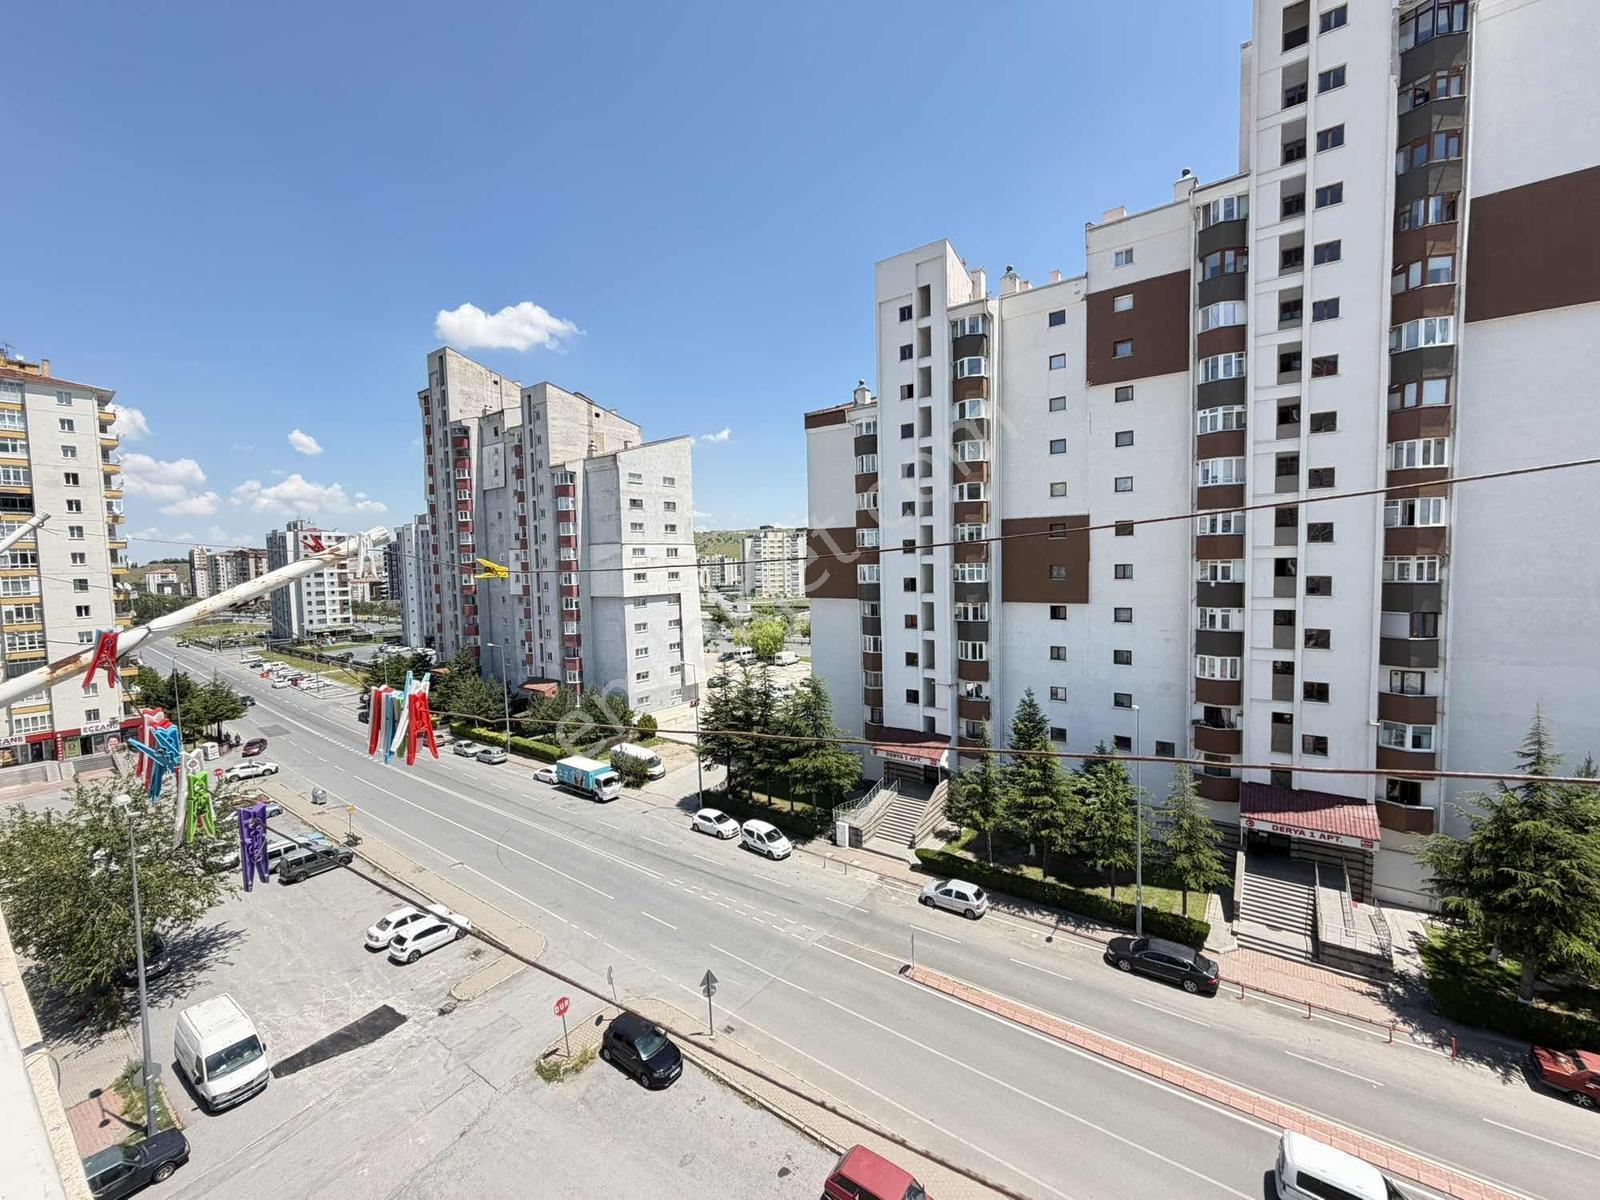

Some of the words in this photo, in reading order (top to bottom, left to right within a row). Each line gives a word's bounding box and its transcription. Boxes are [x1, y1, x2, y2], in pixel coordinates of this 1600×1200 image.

[1272, 824, 1306, 837] DERYA
[1319, 832, 1343, 843] APT.
[554, 999, 569, 1014] DUR
